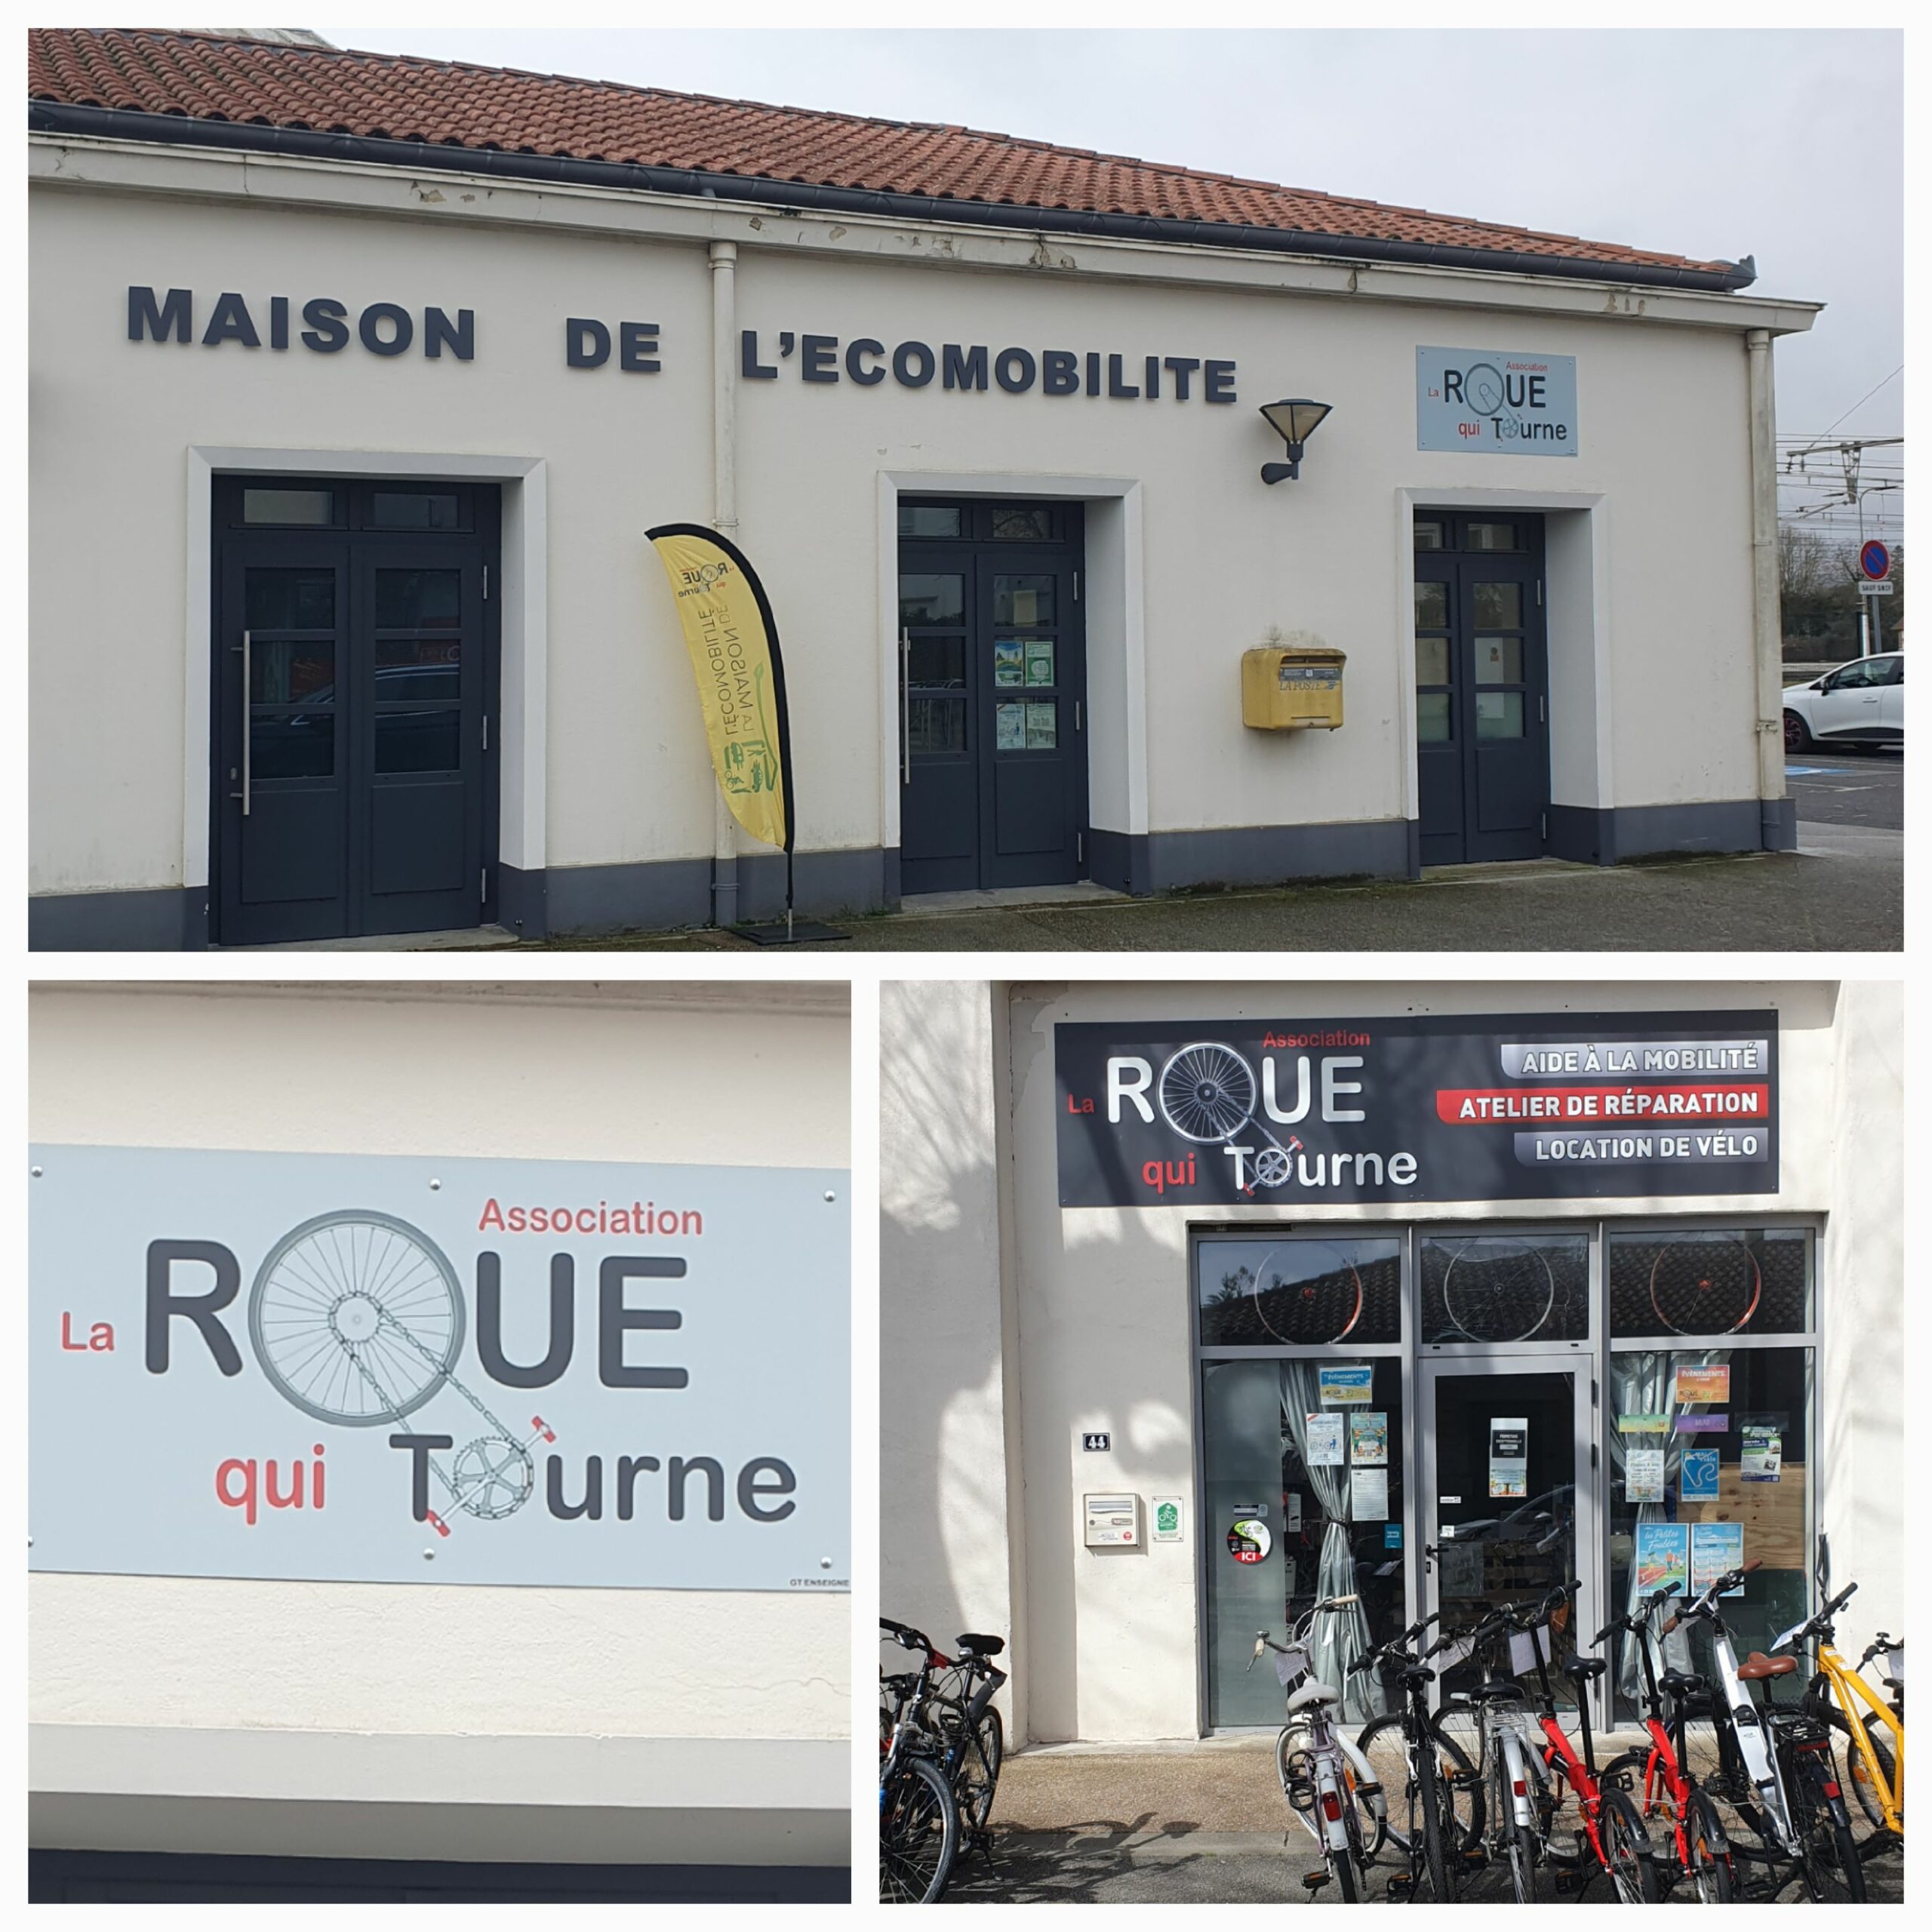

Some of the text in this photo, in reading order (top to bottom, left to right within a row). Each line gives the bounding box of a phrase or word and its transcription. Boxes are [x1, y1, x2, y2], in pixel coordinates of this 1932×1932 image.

[127, 285, 1238, 404] MAISON DE L'ECOMOBILITE
[1506, 361, 1549, 372] Association
[1428, 386, 1439, 397] La
[1458, 417, 1567, 441] qui Tourne
[1280, 681, 1321, 691] LA POSTE
[1262, 1029, 1371, 1048] Association
[1521, 1041, 1758, 1074] AIDE À LA MOBILITÉ
[1068, 1041, 1366, 1143] La ROUE
[1459, 1088, 1758, 1119] ATELIER DE RÉPARATION
[1535, 1128, 1758, 1161] LOCATION DE VÉLO
[1142, 1146, 1418, 1195] qui Tourne
[478, 1198, 703, 1236] Association
[61, 1208, 690, 1427] La ROUE
[1088, 1435, 1106, 1449] 44
[215, 1432, 797, 1525] qui Tourne
[1241, 1552, 1257, 1561] ICI
